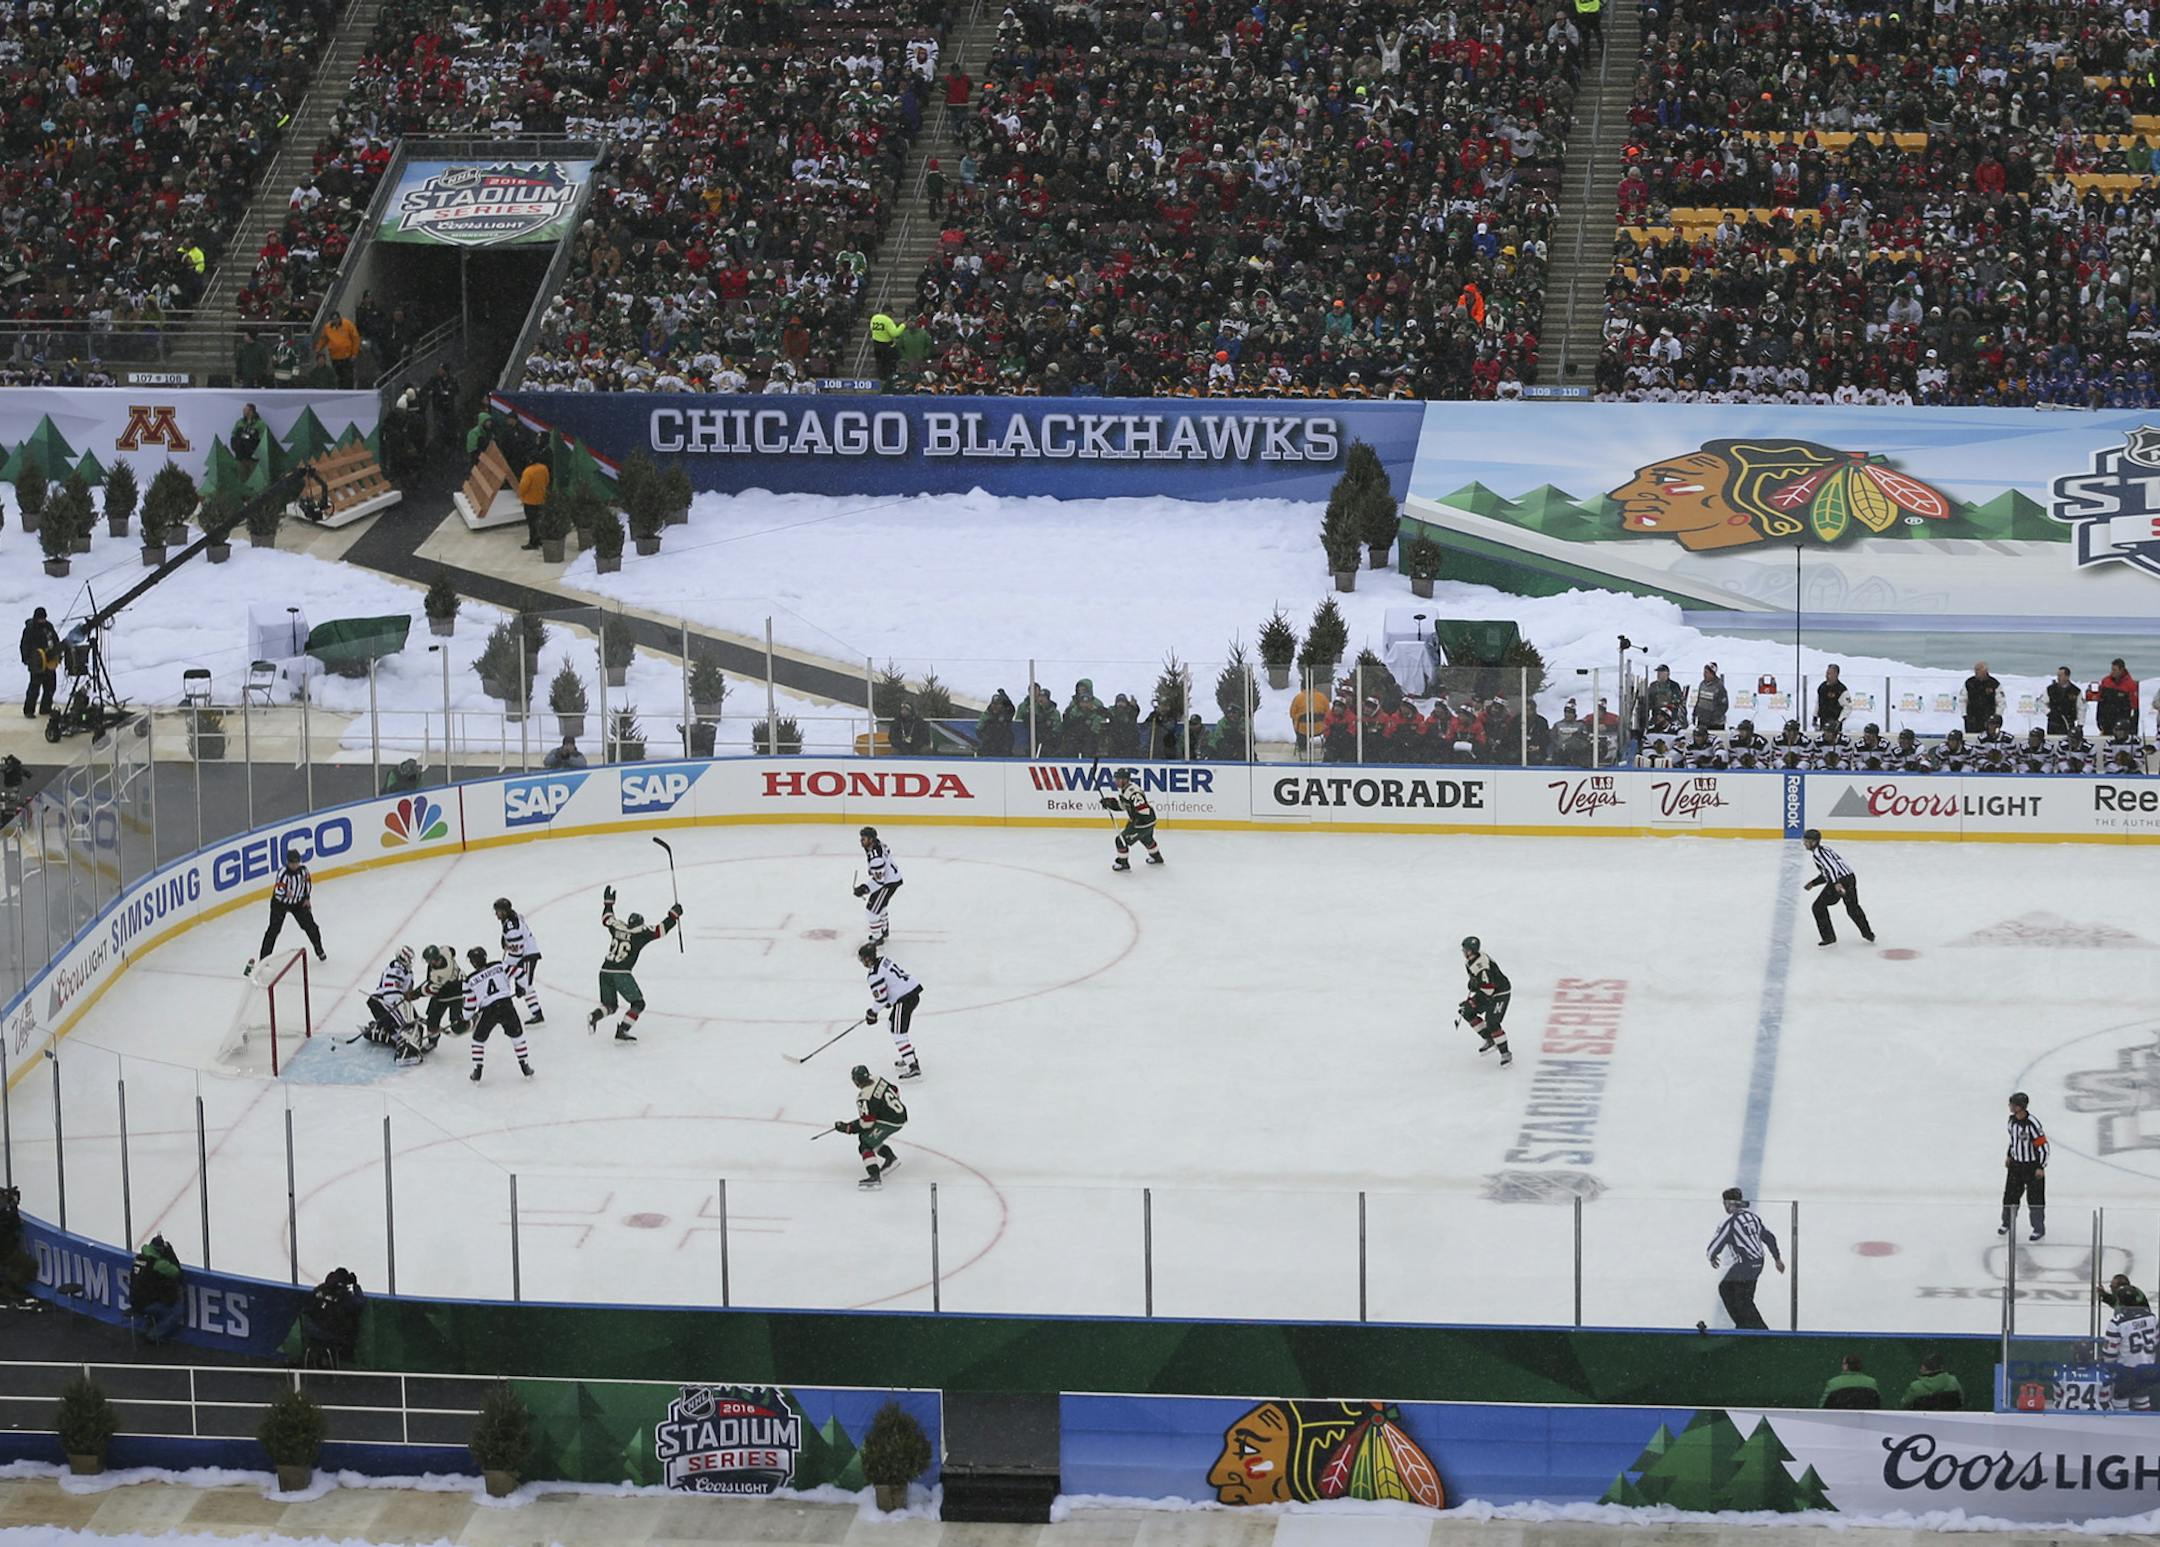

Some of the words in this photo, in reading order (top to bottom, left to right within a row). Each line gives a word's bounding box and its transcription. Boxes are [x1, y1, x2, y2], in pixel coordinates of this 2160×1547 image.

[405, 186, 571, 210] STADIUM
[434, 204, 543, 219] SERIES
[437, 221, 483, 230] Coors
[483, 221, 526, 229] LIGHT
[136, 374, 152, 383] 107
[1532, 387, 1551, 396] 109
[1562, 388, 1580, 396] 110
[116, 405, 190, 452] M
[650, 408, 908, 455] CHICAGO
[923, 412, 1338, 461] BLACKHAWKS
[621, 773, 690, 807] SAP
[762, 771, 975, 799] HONDA
[1273, 778, 1485, 808] GATORADE
[1591, 777, 1614, 790] LAS
[1694, 778, 1717, 791] LAS
[505, 784, 570, 820] SAP
[1047, 800, 1083, 811] Brake
[1150, 800, 1217, 813] onfidence.
[1548, 779, 1626, 818] Vegas
[1651, 780, 1729, 819] Vegas
[1787, 775, 1800, 829] Reebok
[1867, 784, 1960, 817] Coors
[1963, 796, 2043, 817] LIGHT
[2095, 818, 2117, 827] THE
[213, 816, 353, 893] GEICO
[112, 866, 202, 955] SAMSUNG
[85, 938, 108, 980] LIGHT
[486, 978, 501, 996] 4
[1541, 977, 1630, 1056] SERIES
[884, 1088, 904, 1114] 6
[1504, 1059, 1611, 1166] STADIUM
[116, 1266, 250, 1338] SIES
[2128, 1327, 2156, 1355] 65
[687, 1392, 709, 1411] NHL
[722, 1403, 756, 1414] 2016
[2065, 1383, 2097, 1411] 24
[660, 1418, 797, 1458] STADIUM
[688, 1452, 778, 1472] SERIES
[1881, 1433, 2048, 1491] Coors
[2055, 1454, 2160, 1491] LIGH
[695, 1478, 733, 1493] Coors
[734, 1482, 769, 1494] LIGHT
